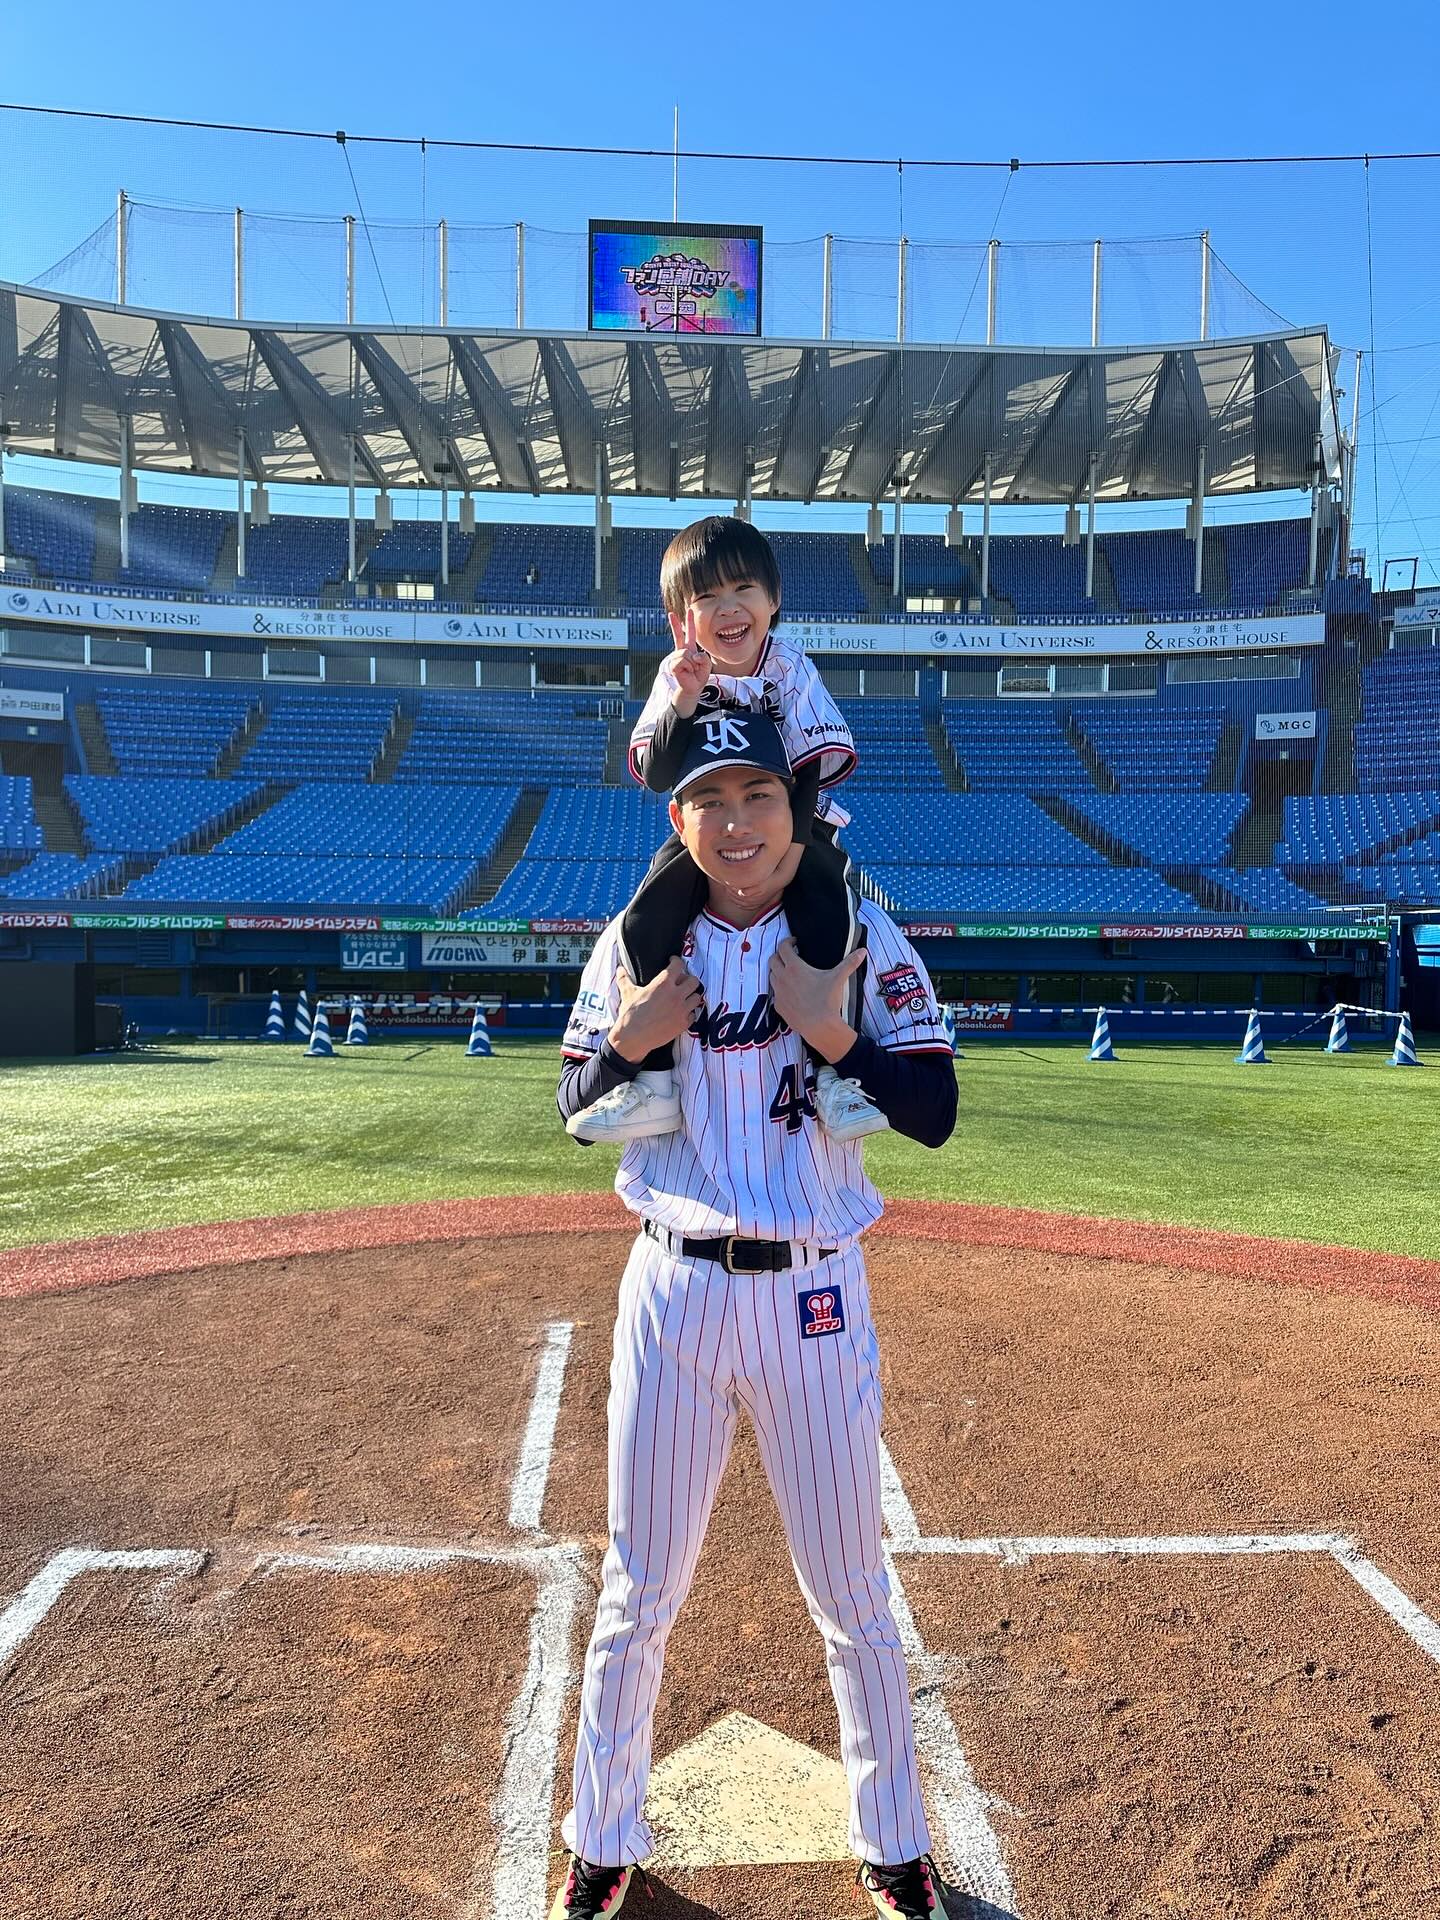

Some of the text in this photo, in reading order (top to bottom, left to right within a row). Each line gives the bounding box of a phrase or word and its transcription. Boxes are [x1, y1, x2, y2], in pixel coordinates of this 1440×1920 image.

[35, 596, 201, 626] AIM UNIVERSE
[275, 623, 336, 636] RESORT
[343, 625, 393, 638] HOUSE
[465, 622, 613, 641] AIM UNIVERSE
[830, 638, 878, 649] HOUSE
[952, 631, 1095, 648] AIM UNIVERSE
[1167, 635, 1228, 648] RESORT
[1236, 632, 1288, 645] HOUSE
[803, 722, 849, 738] Yakul
[1278, 720, 1312, 730] MGC
[532, 922, 609, 932] 宅配ボックスはフル
[342, 951, 405, 969] UACJ
[426, 947, 488, 961] ITOCHU
[897, 974, 918, 993] 55
[806, 1319, 840, 1333] タフマン
